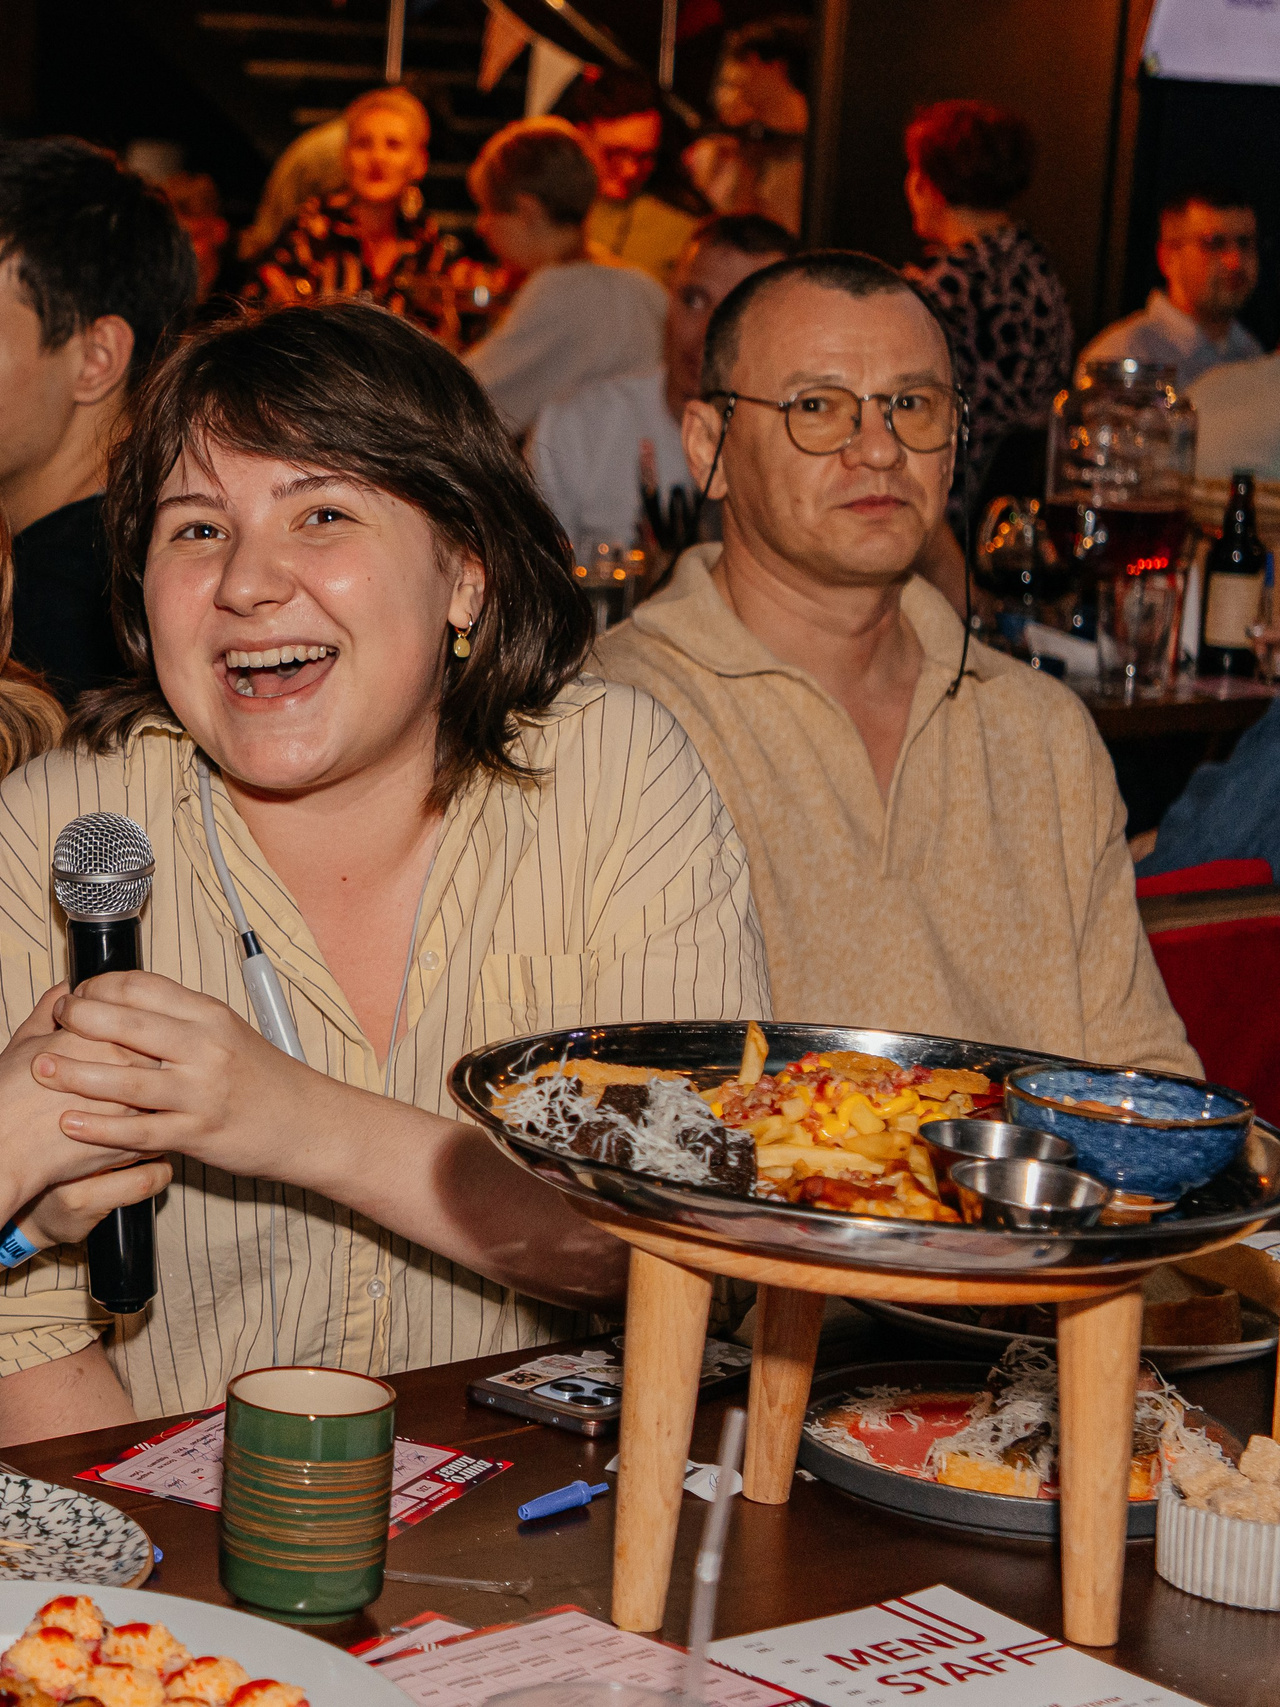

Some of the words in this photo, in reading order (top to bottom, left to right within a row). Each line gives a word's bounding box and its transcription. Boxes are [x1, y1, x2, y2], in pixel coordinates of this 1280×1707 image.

[434, 1455, 477, 1479] ПЛИЗ!
[444, 1459, 494, 1484] БИНГО,
[823, 1597, 987, 1672] MENU
[876, 1636, 1068, 1696] STAFF
